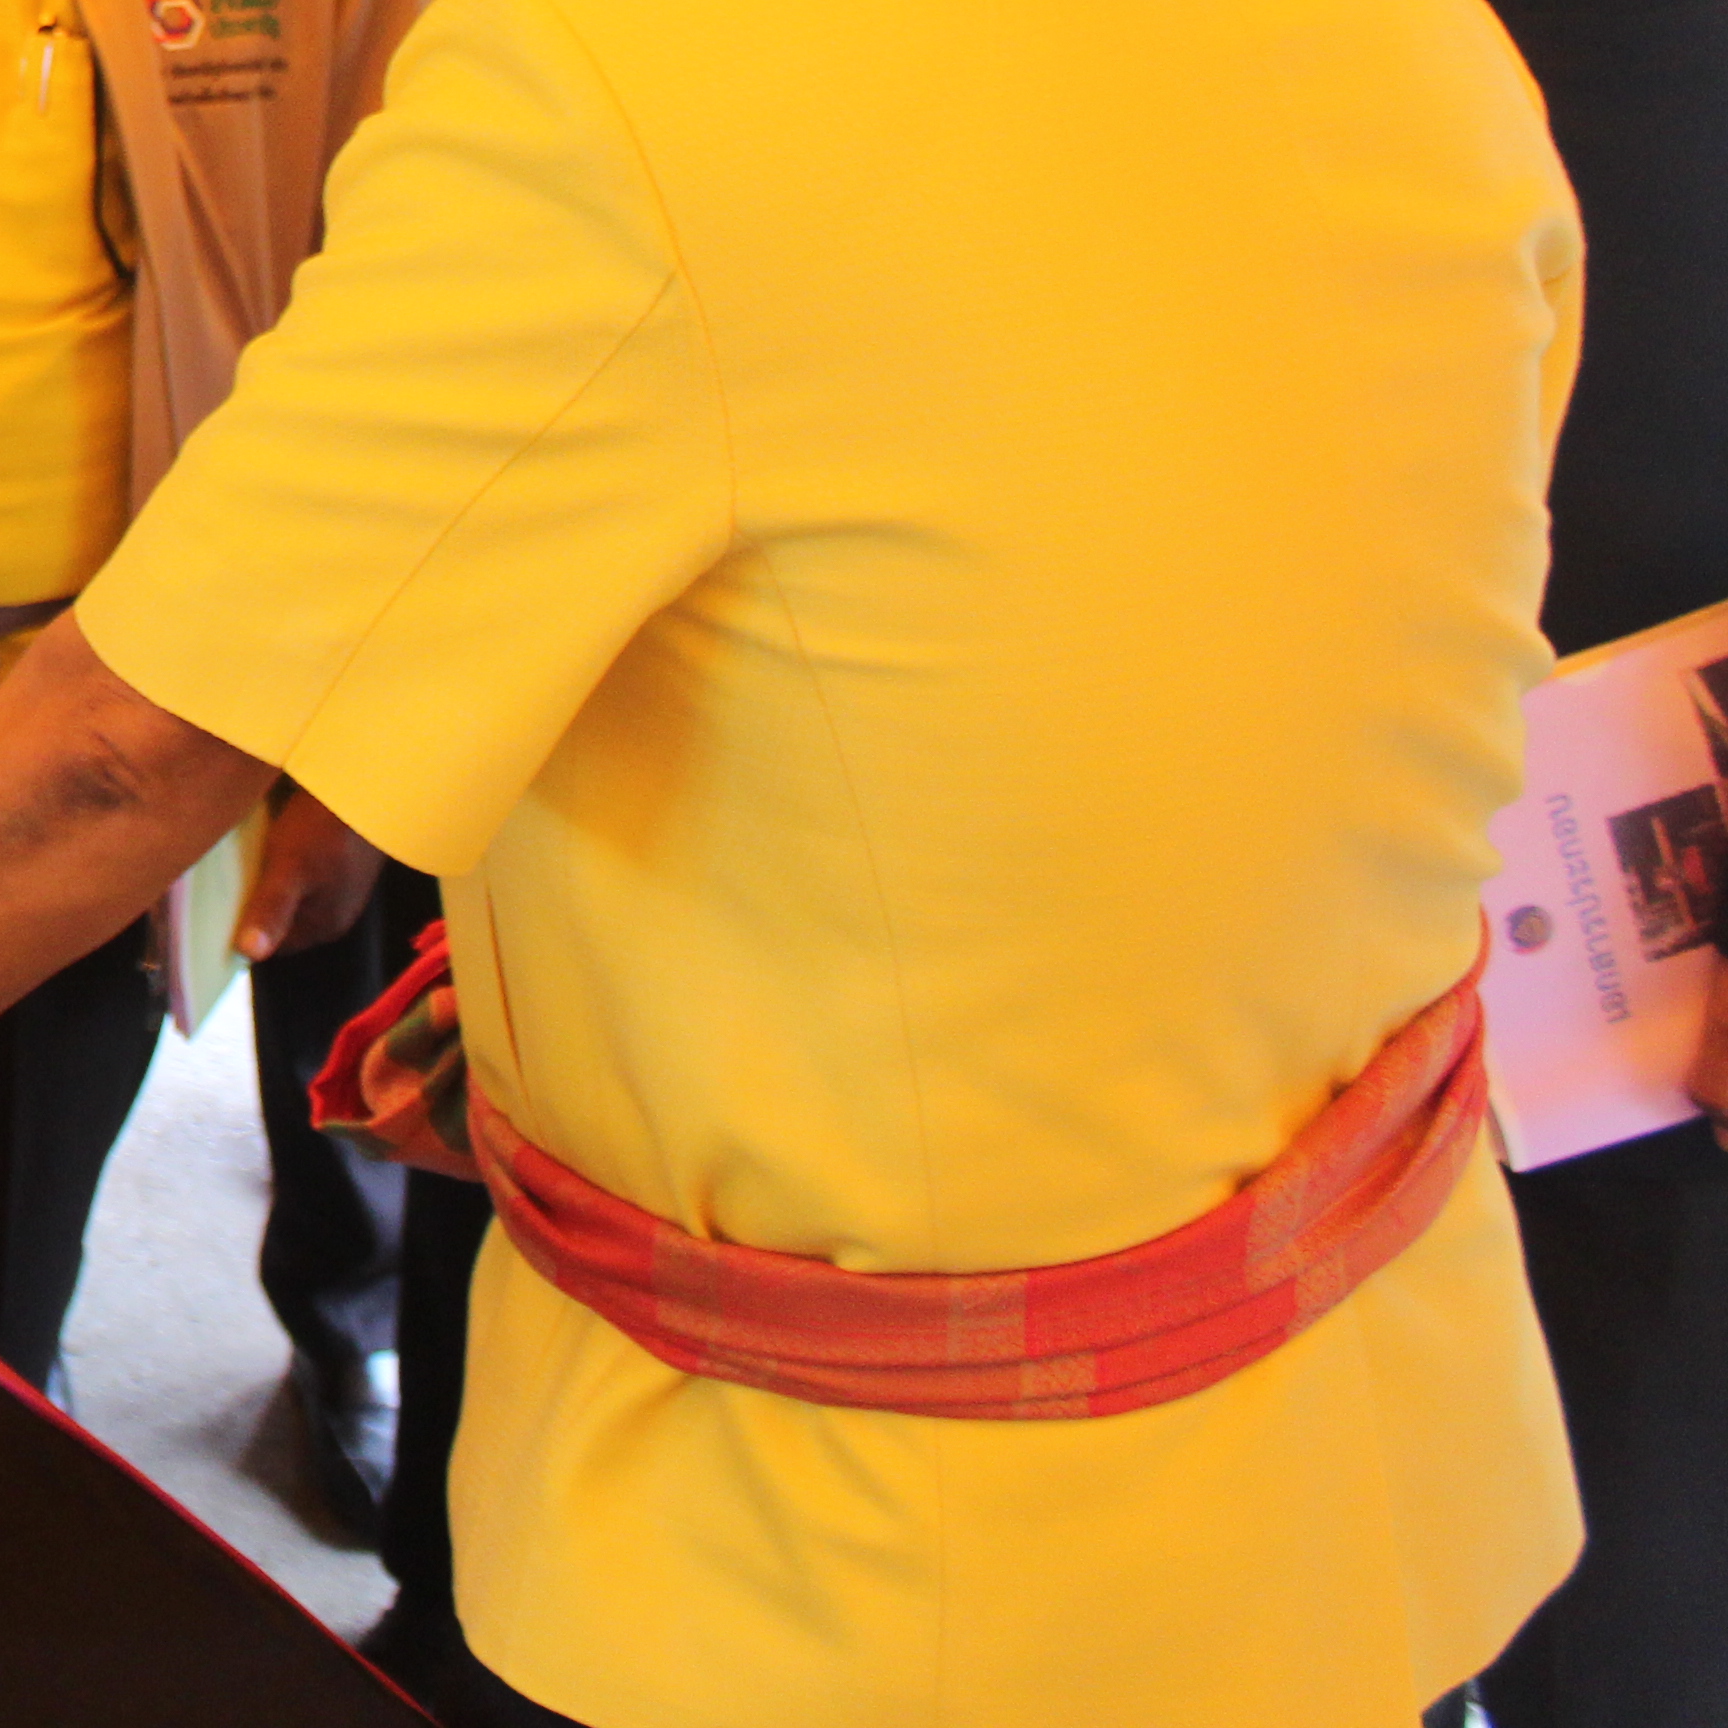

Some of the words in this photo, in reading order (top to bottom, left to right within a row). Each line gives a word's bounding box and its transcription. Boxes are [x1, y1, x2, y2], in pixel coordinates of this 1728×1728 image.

[1547, 794, 1631, 1024] เอกสารประกอบ
